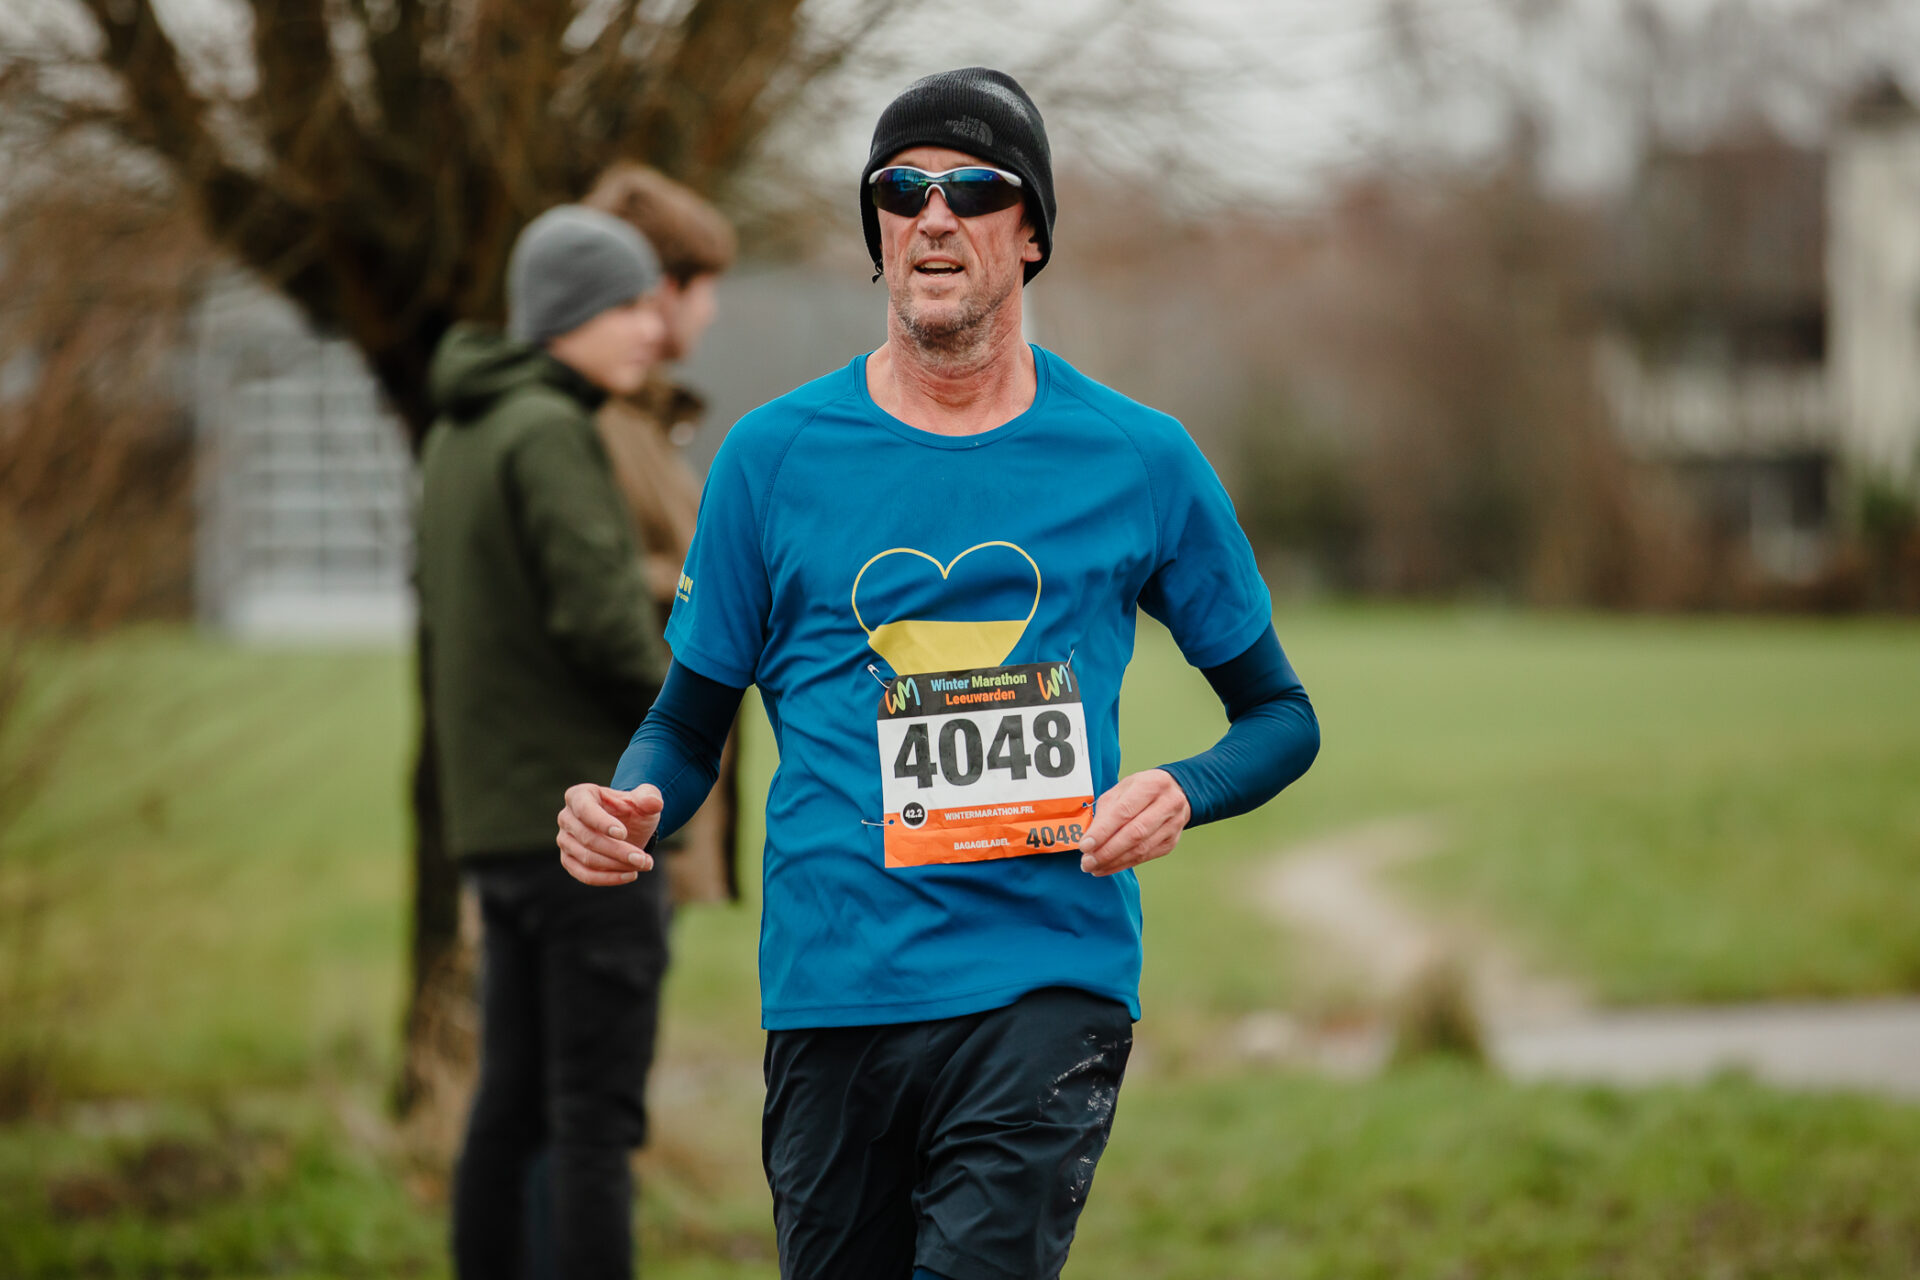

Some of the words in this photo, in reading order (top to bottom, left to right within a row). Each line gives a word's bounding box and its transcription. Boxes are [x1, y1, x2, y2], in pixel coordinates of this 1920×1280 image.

[945, 120, 979, 132] NORTH
[962, 115, 980, 125] THE
[952, 126, 978, 138] FACE
[930, 677, 969, 692] Winter
[971, 673, 1028, 688] Marathon
[945, 688, 1016, 706] Leeuwarden
[893, 710, 1076, 789] 4048
[904, 809, 923, 819] 42.2
[944, 805, 1035, 821] WINTERMARATHON.FRL
[1026, 823, 1084, 849] 4048
[953, 838, 1010, 851] BAGAGELABEL
